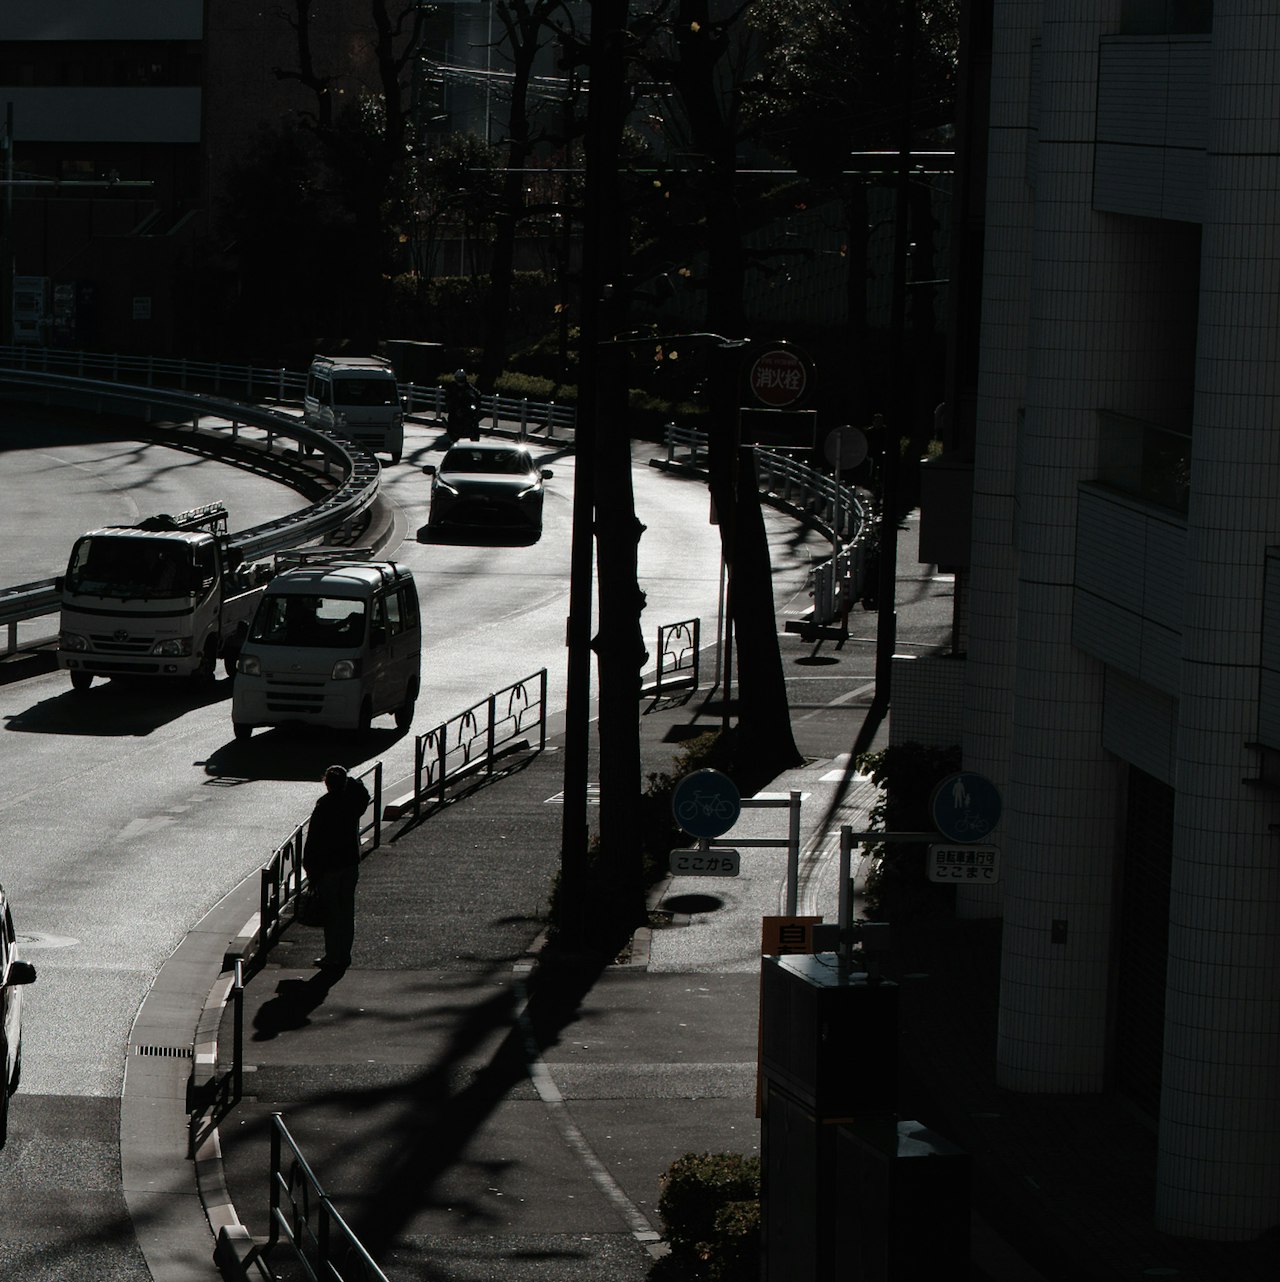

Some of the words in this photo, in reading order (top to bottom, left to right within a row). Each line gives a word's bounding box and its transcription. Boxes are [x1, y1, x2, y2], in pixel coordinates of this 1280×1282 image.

[756, 367, 800, 390] 消火栓
[678, 857, 734, 871] ここから
[936, 866, 993, 879] ここまで
